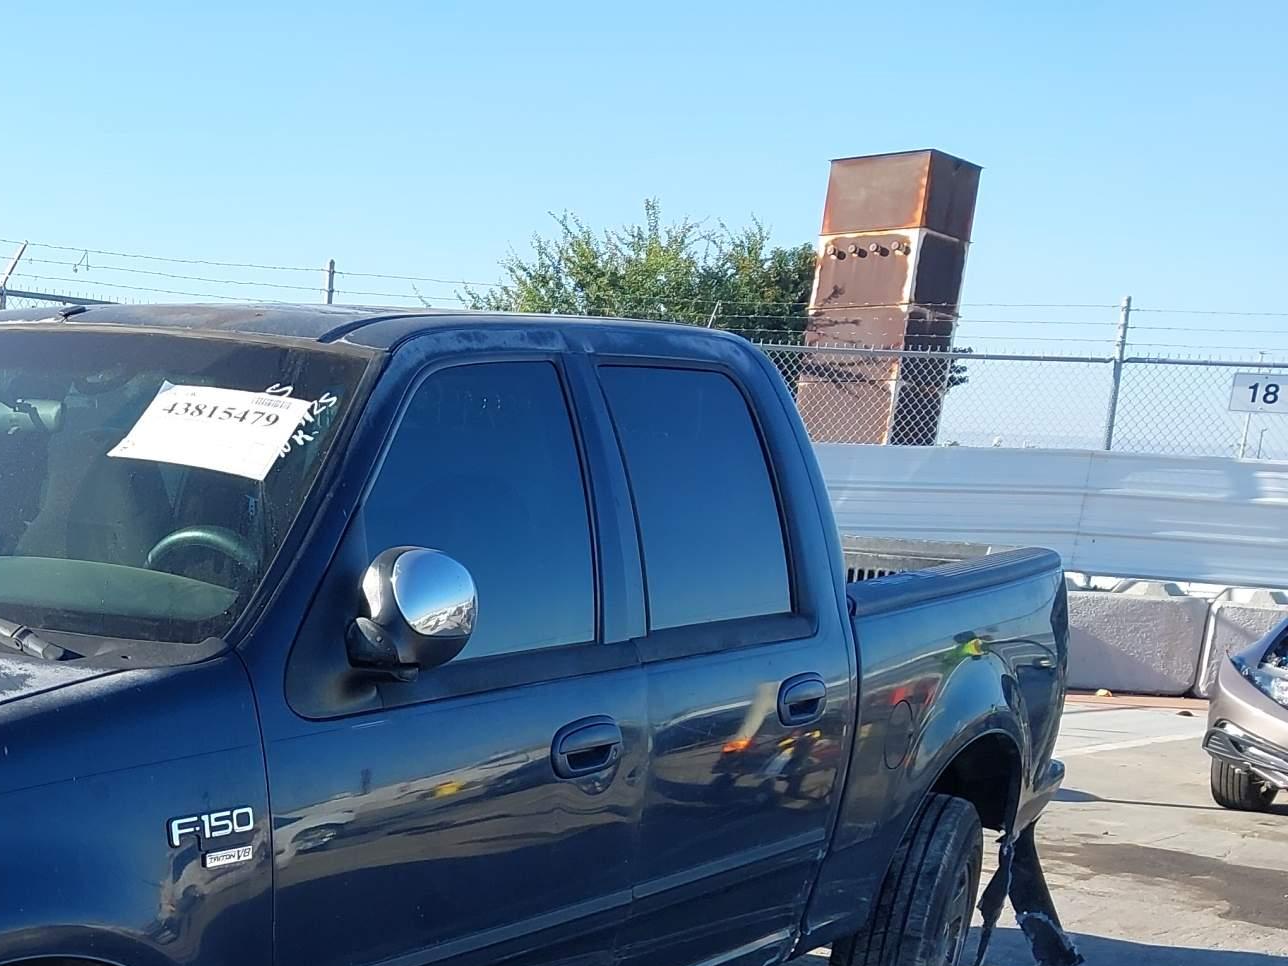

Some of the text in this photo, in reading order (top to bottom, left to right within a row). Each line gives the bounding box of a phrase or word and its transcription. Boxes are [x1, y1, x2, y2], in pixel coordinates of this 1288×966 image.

[1248, 382, 1281, 405] 18
[162, 399, 281, 428] 43815479
[236, 847, 251, 861] V8
